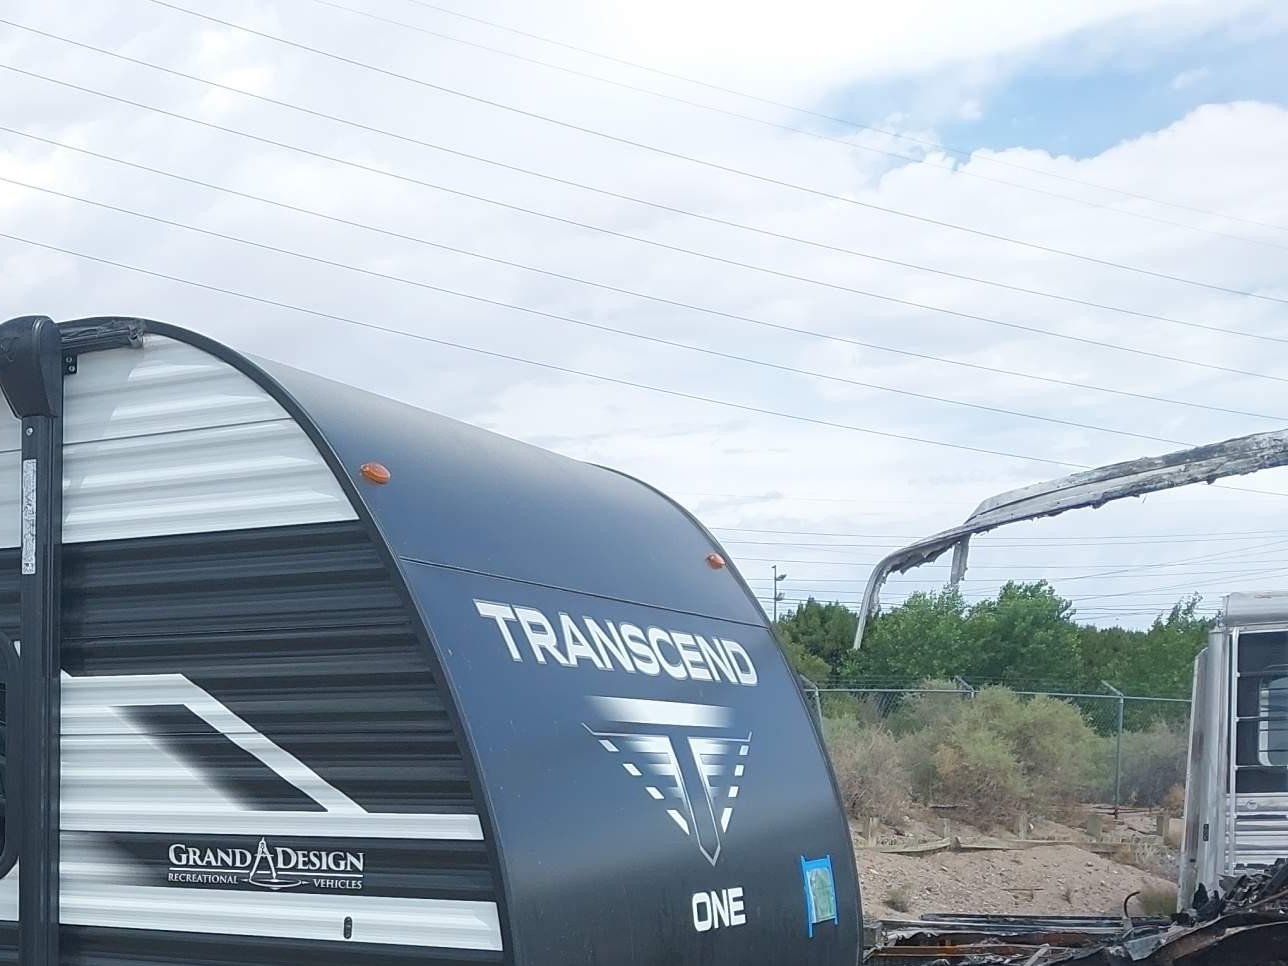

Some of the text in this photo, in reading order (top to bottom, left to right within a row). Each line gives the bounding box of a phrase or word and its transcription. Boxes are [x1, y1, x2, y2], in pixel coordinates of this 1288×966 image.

[472, 598, 759, 687] TRANSCEND
[168, 843, 365, 872] GRAND DESIGN
[167, 872, 363, 890] RECREATIONAL VEHICLES
[691, 886, 747, 933] ONE
